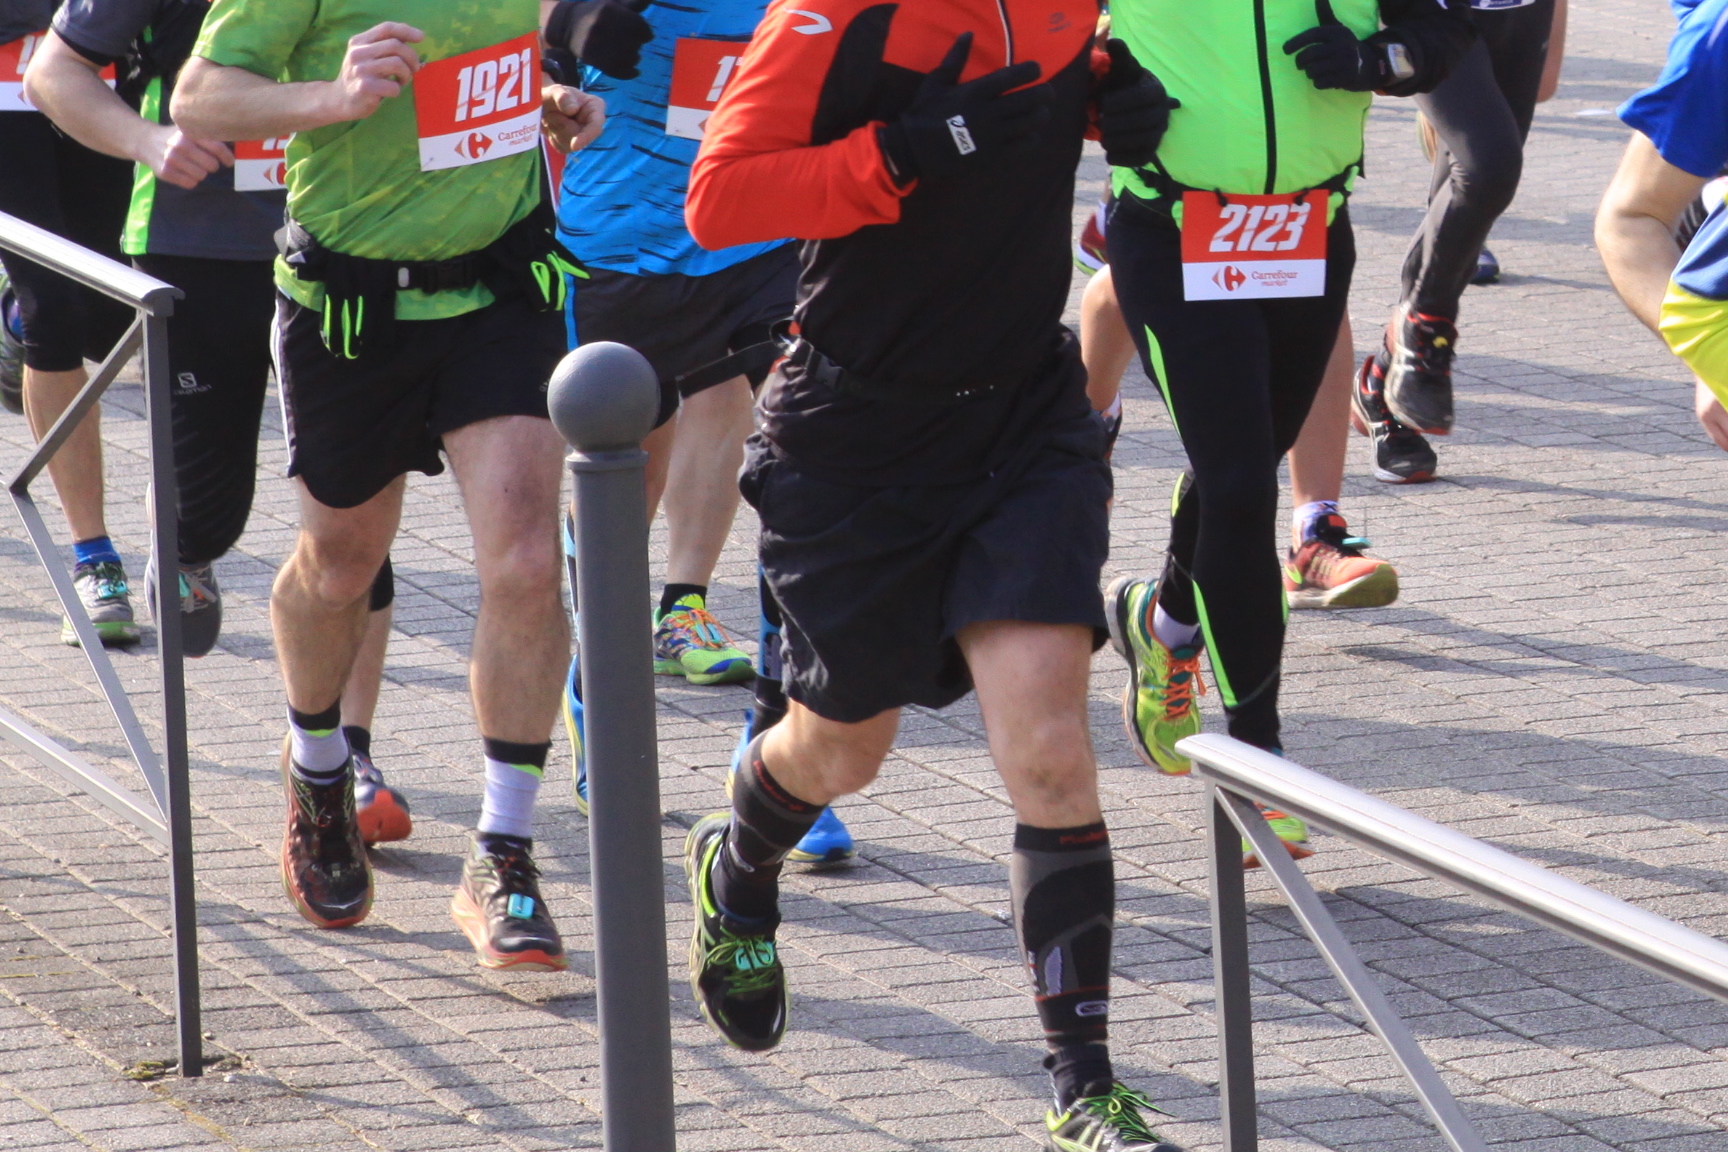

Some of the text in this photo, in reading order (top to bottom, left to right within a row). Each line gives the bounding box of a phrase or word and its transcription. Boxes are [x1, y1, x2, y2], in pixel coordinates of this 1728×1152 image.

[455, 47, 532, 123] 1921
[498, 124, 538, 142] Carrefour
[1209, 202, 1312, 253] 2123
[1251, 269, 1298, 281] Carrefour
